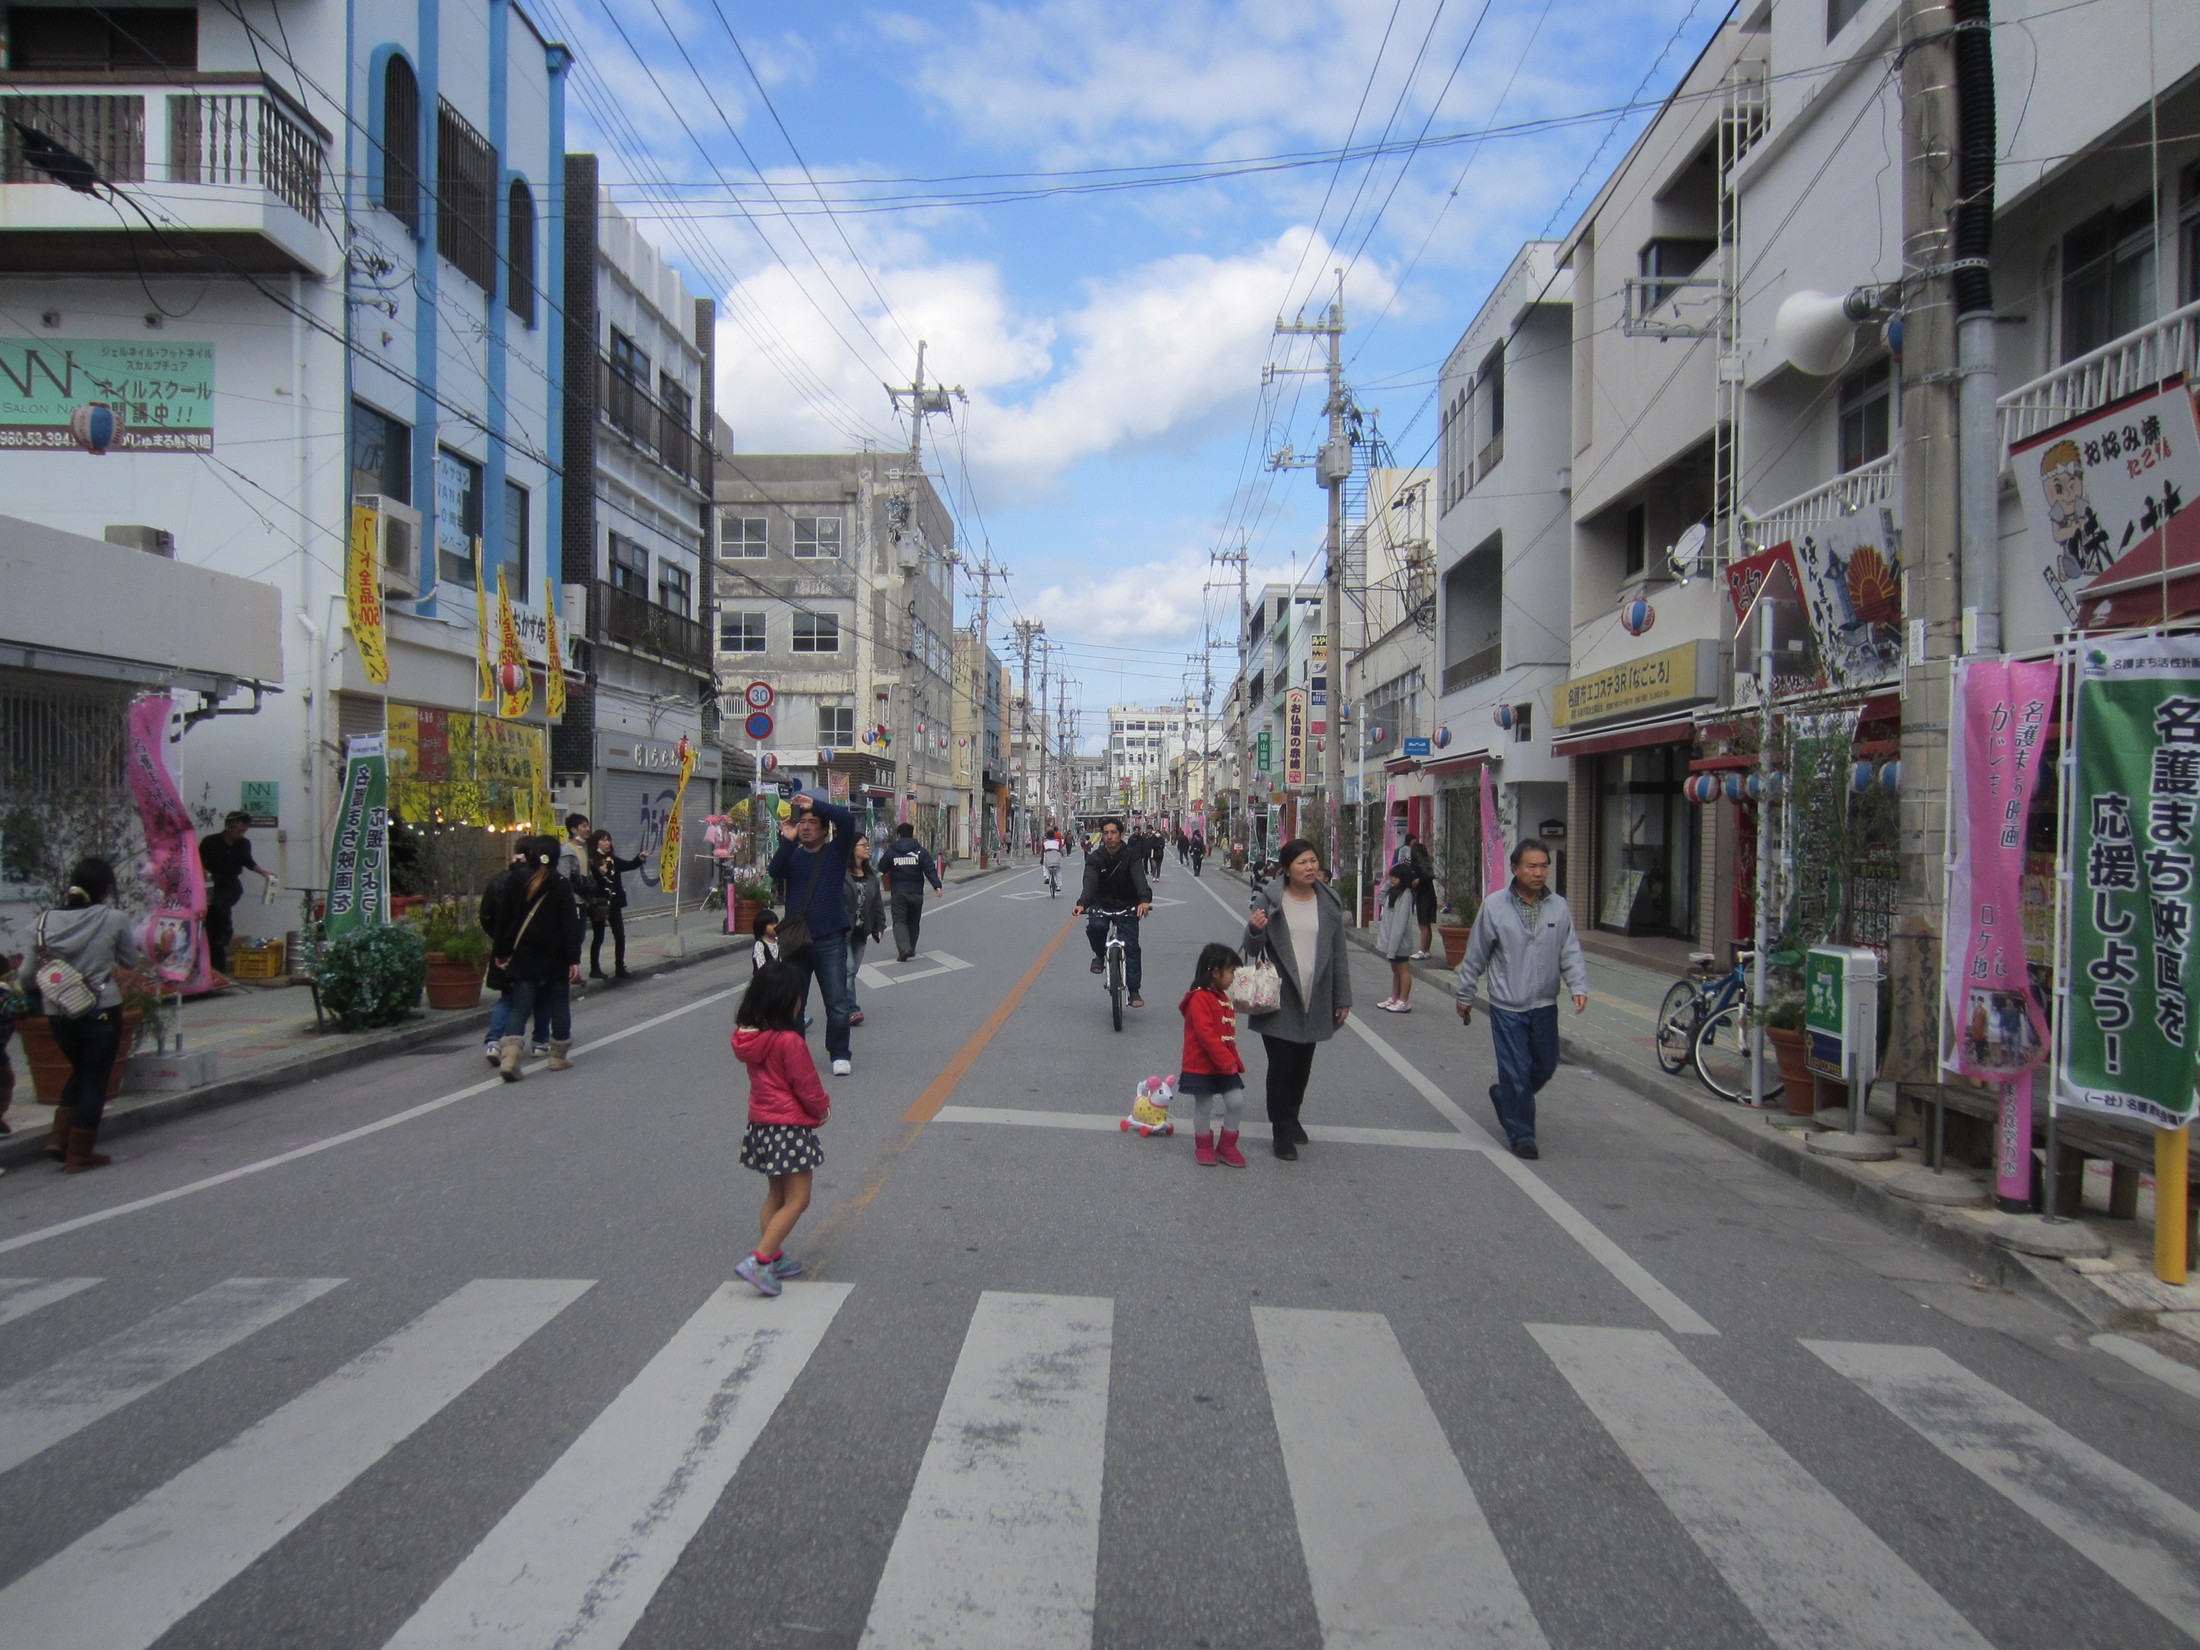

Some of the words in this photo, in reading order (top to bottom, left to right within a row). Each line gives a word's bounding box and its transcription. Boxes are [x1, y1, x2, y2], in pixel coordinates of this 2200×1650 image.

[100, 379, 211, 400] ネイルスクール
[752, 689, 768, 702] 30
[2000, 700, 2045, 849] 名護まち映画
[2144, 695, 2200, 1047] 名護まち映画を
[1970, 905, 1993, 980] ロケ地
[2087, 793, 2138, 1076] 応援しよう！
